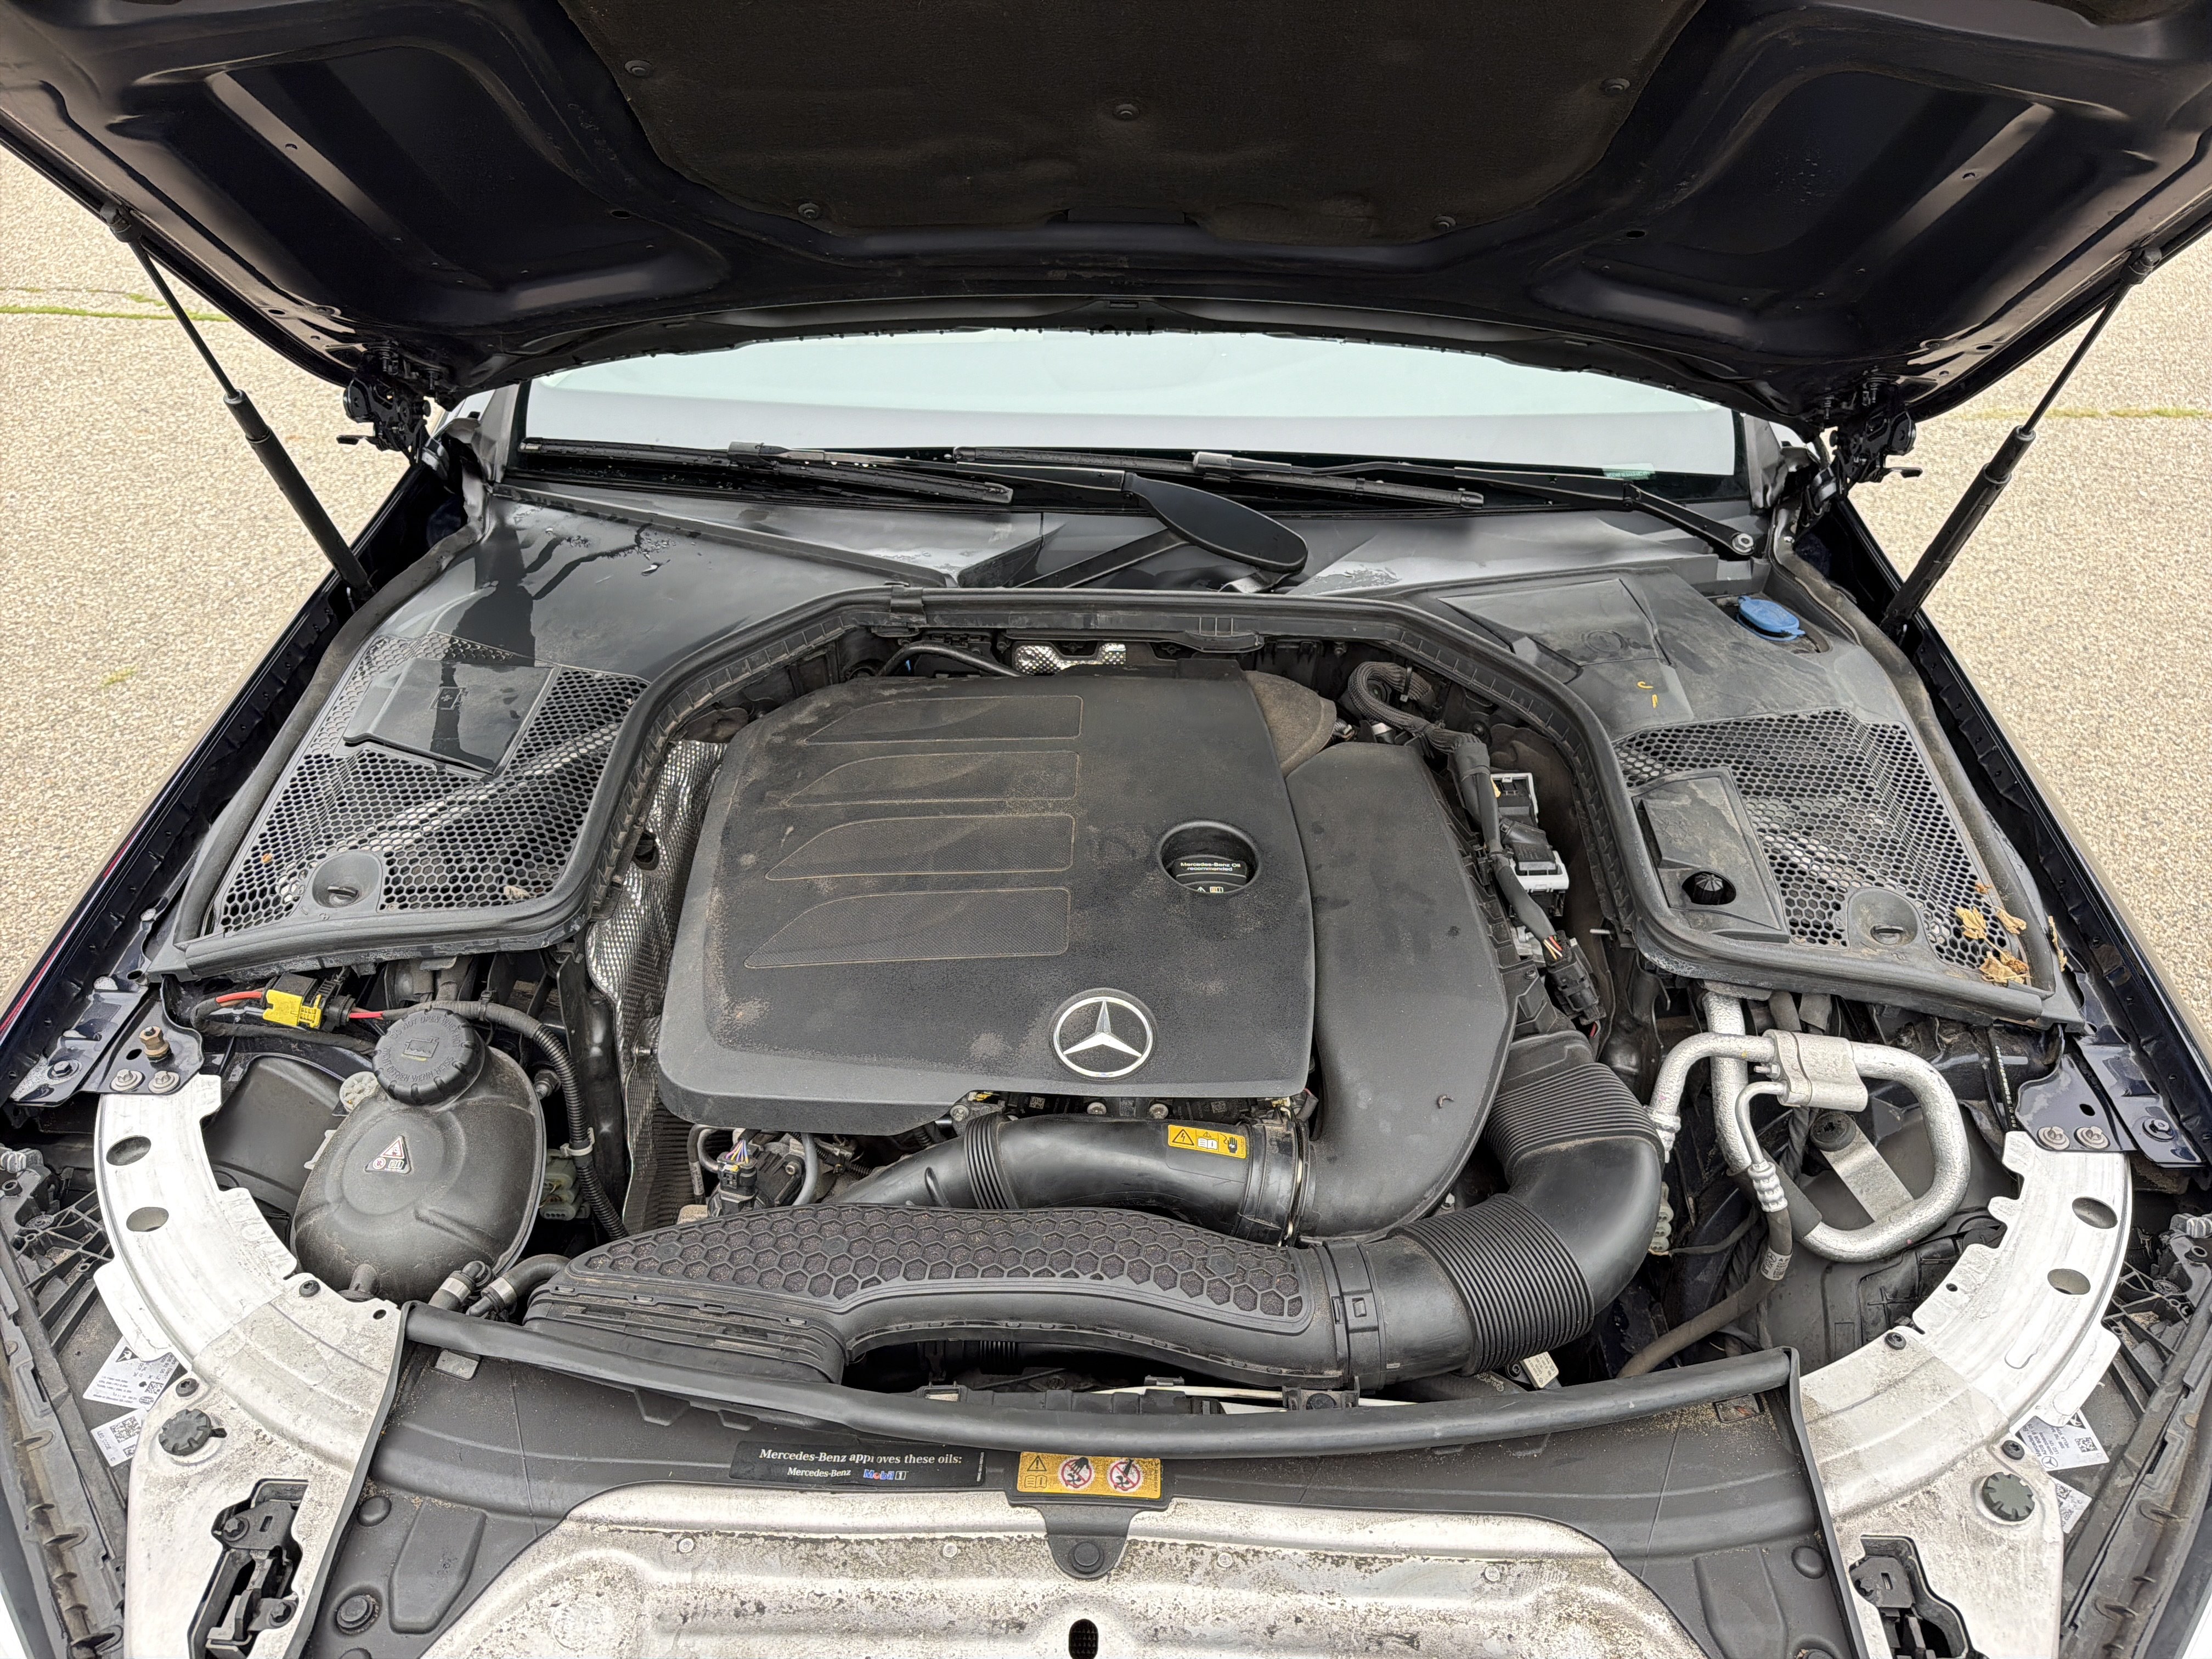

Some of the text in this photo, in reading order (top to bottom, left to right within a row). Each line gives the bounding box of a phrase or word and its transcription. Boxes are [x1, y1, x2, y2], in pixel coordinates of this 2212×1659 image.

[390, 1029, 403, 1040] DO
[402, 1018, 417, 1030] NOT
[420, 1015, 441, 1024] OPEN
[441, 1018, 459, 1036] WHEN
[411, 1070, 433, 1082] WENN
[759, 1448, 963, 1464] Mercedes-Benz approves these oils:
[787, 1466, 852, 1477] Mercedes-Benz
[862, 1469, 895, 1481] Mobil
